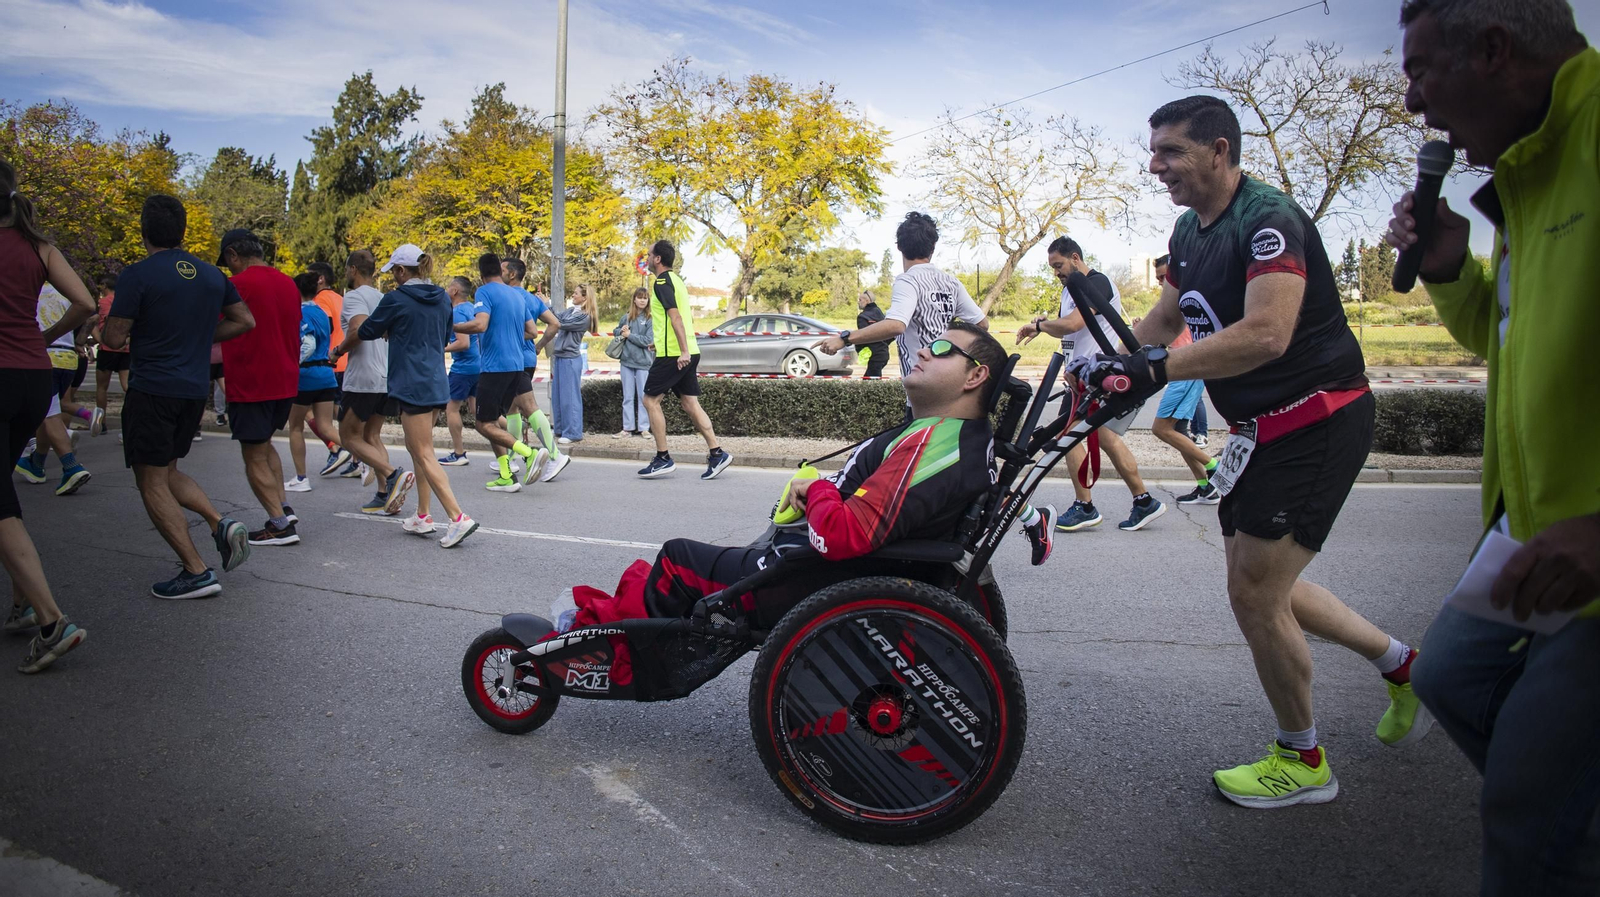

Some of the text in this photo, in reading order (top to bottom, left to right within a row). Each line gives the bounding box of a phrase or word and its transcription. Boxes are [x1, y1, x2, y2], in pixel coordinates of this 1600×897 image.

[987, 494, 1022, 548] MARATHON
[556, 628, 626, 640] MARATHON
[564, 669, 611, 690] M1
[856, 617, 984, 748] MARATHON
[916, 663, 981, 725] HIPPOCAMPE
